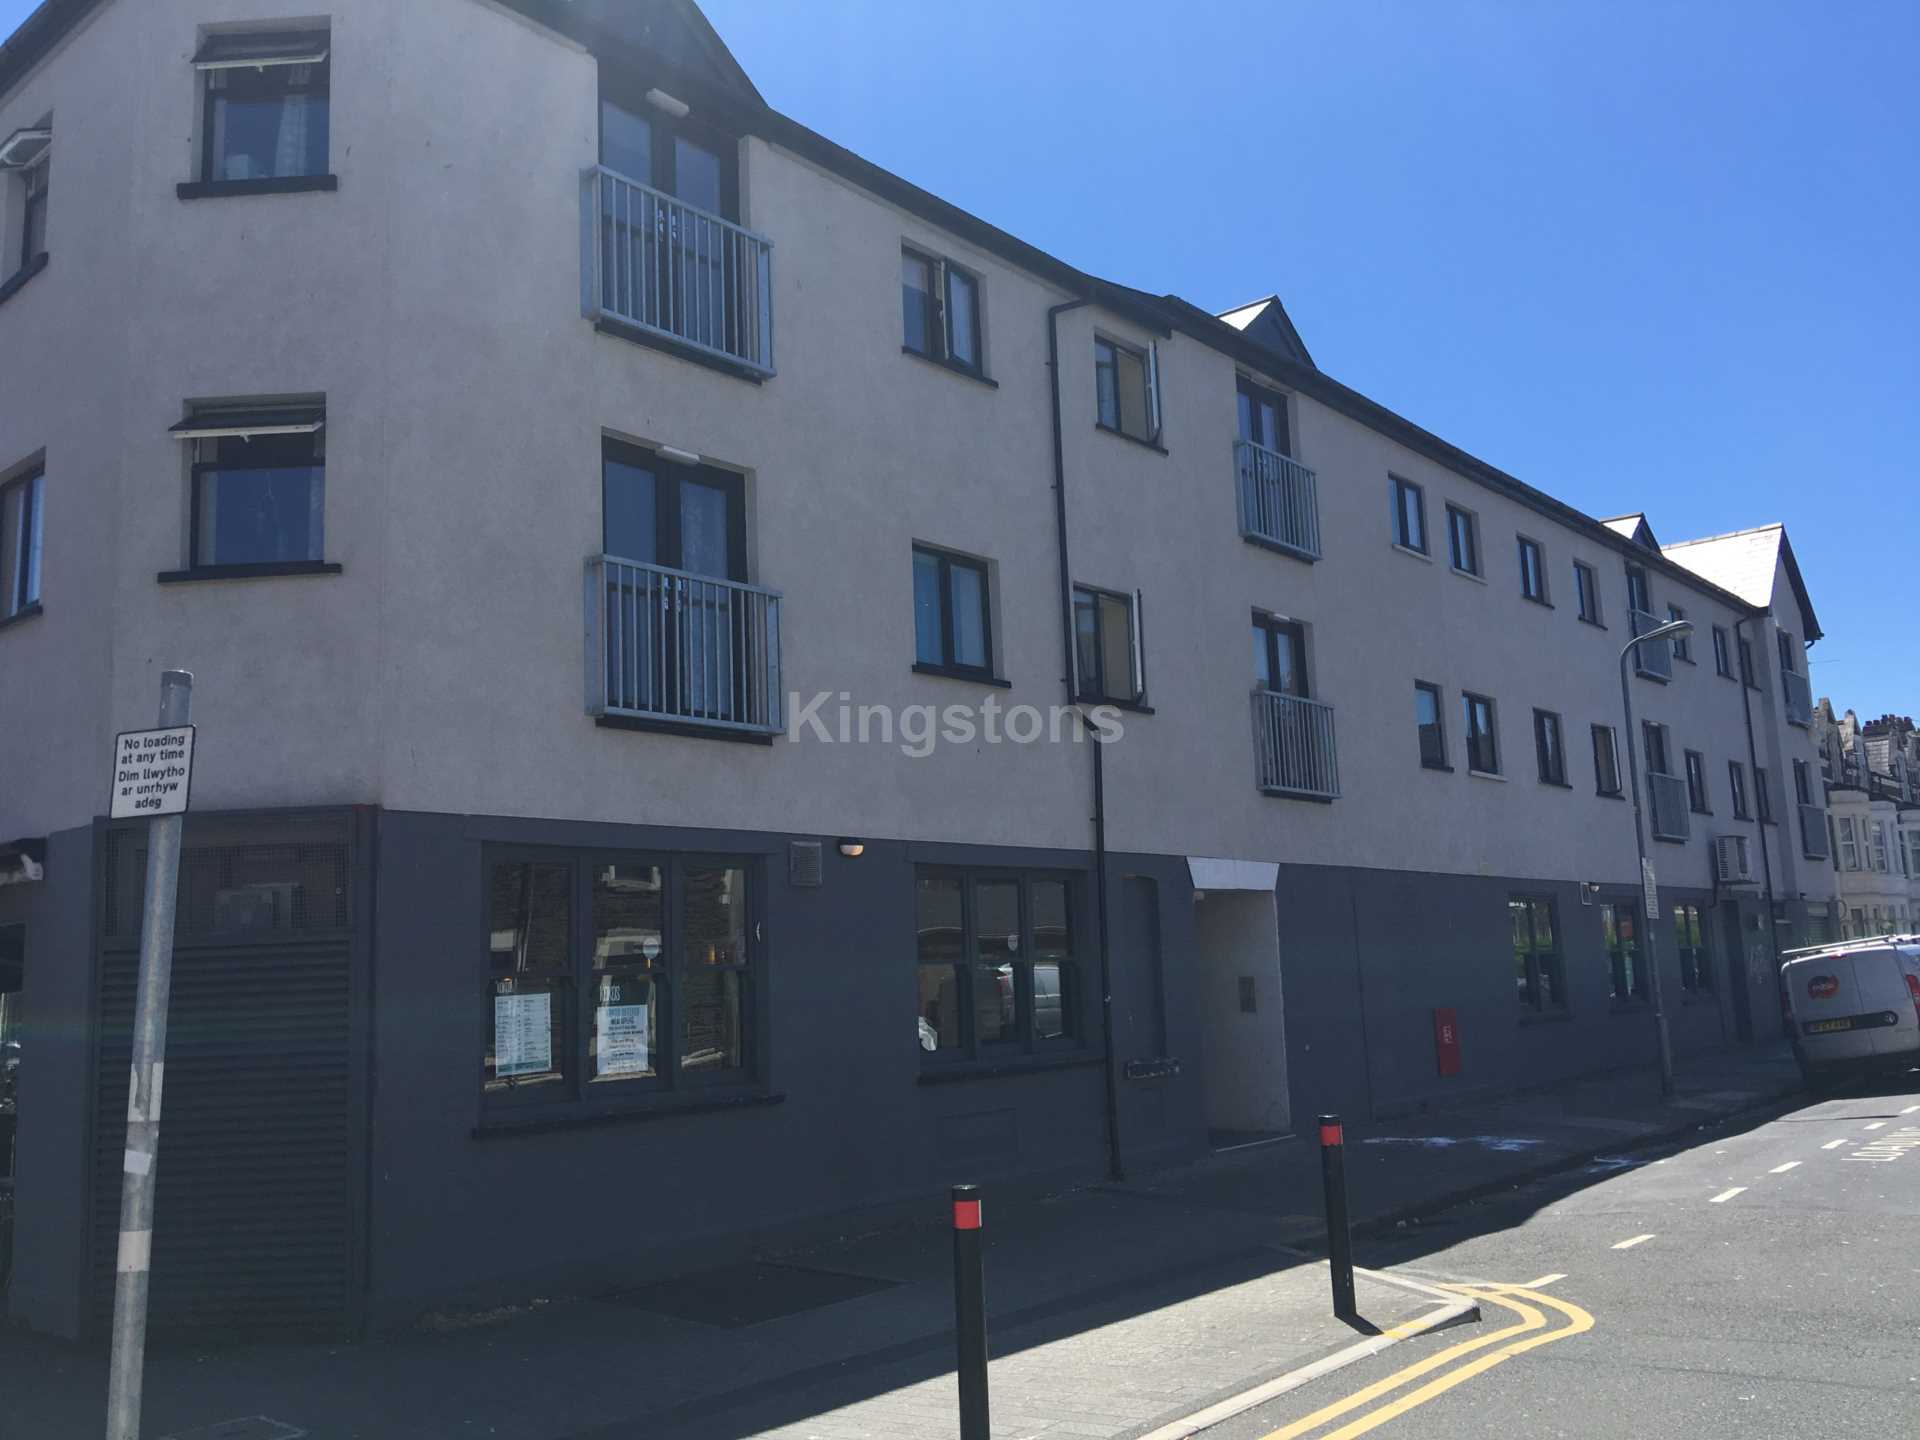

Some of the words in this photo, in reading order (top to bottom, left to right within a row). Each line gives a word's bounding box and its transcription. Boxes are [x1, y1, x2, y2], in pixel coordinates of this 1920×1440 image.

[124, 739, 140, 750] No
[143, 735, 185, 749] loading
[121, 754, 133, 764] at
[136, 753, 156, 764] any
[160, 749, 185, 761] time
[118, 771, 140, 782] Dim
[143, 766, 185, 780] llwytho
[121, 787, 133, 796] ar
[136, 782, 179, 795] unrhyw
[134, 797, 162, 809] adeg
